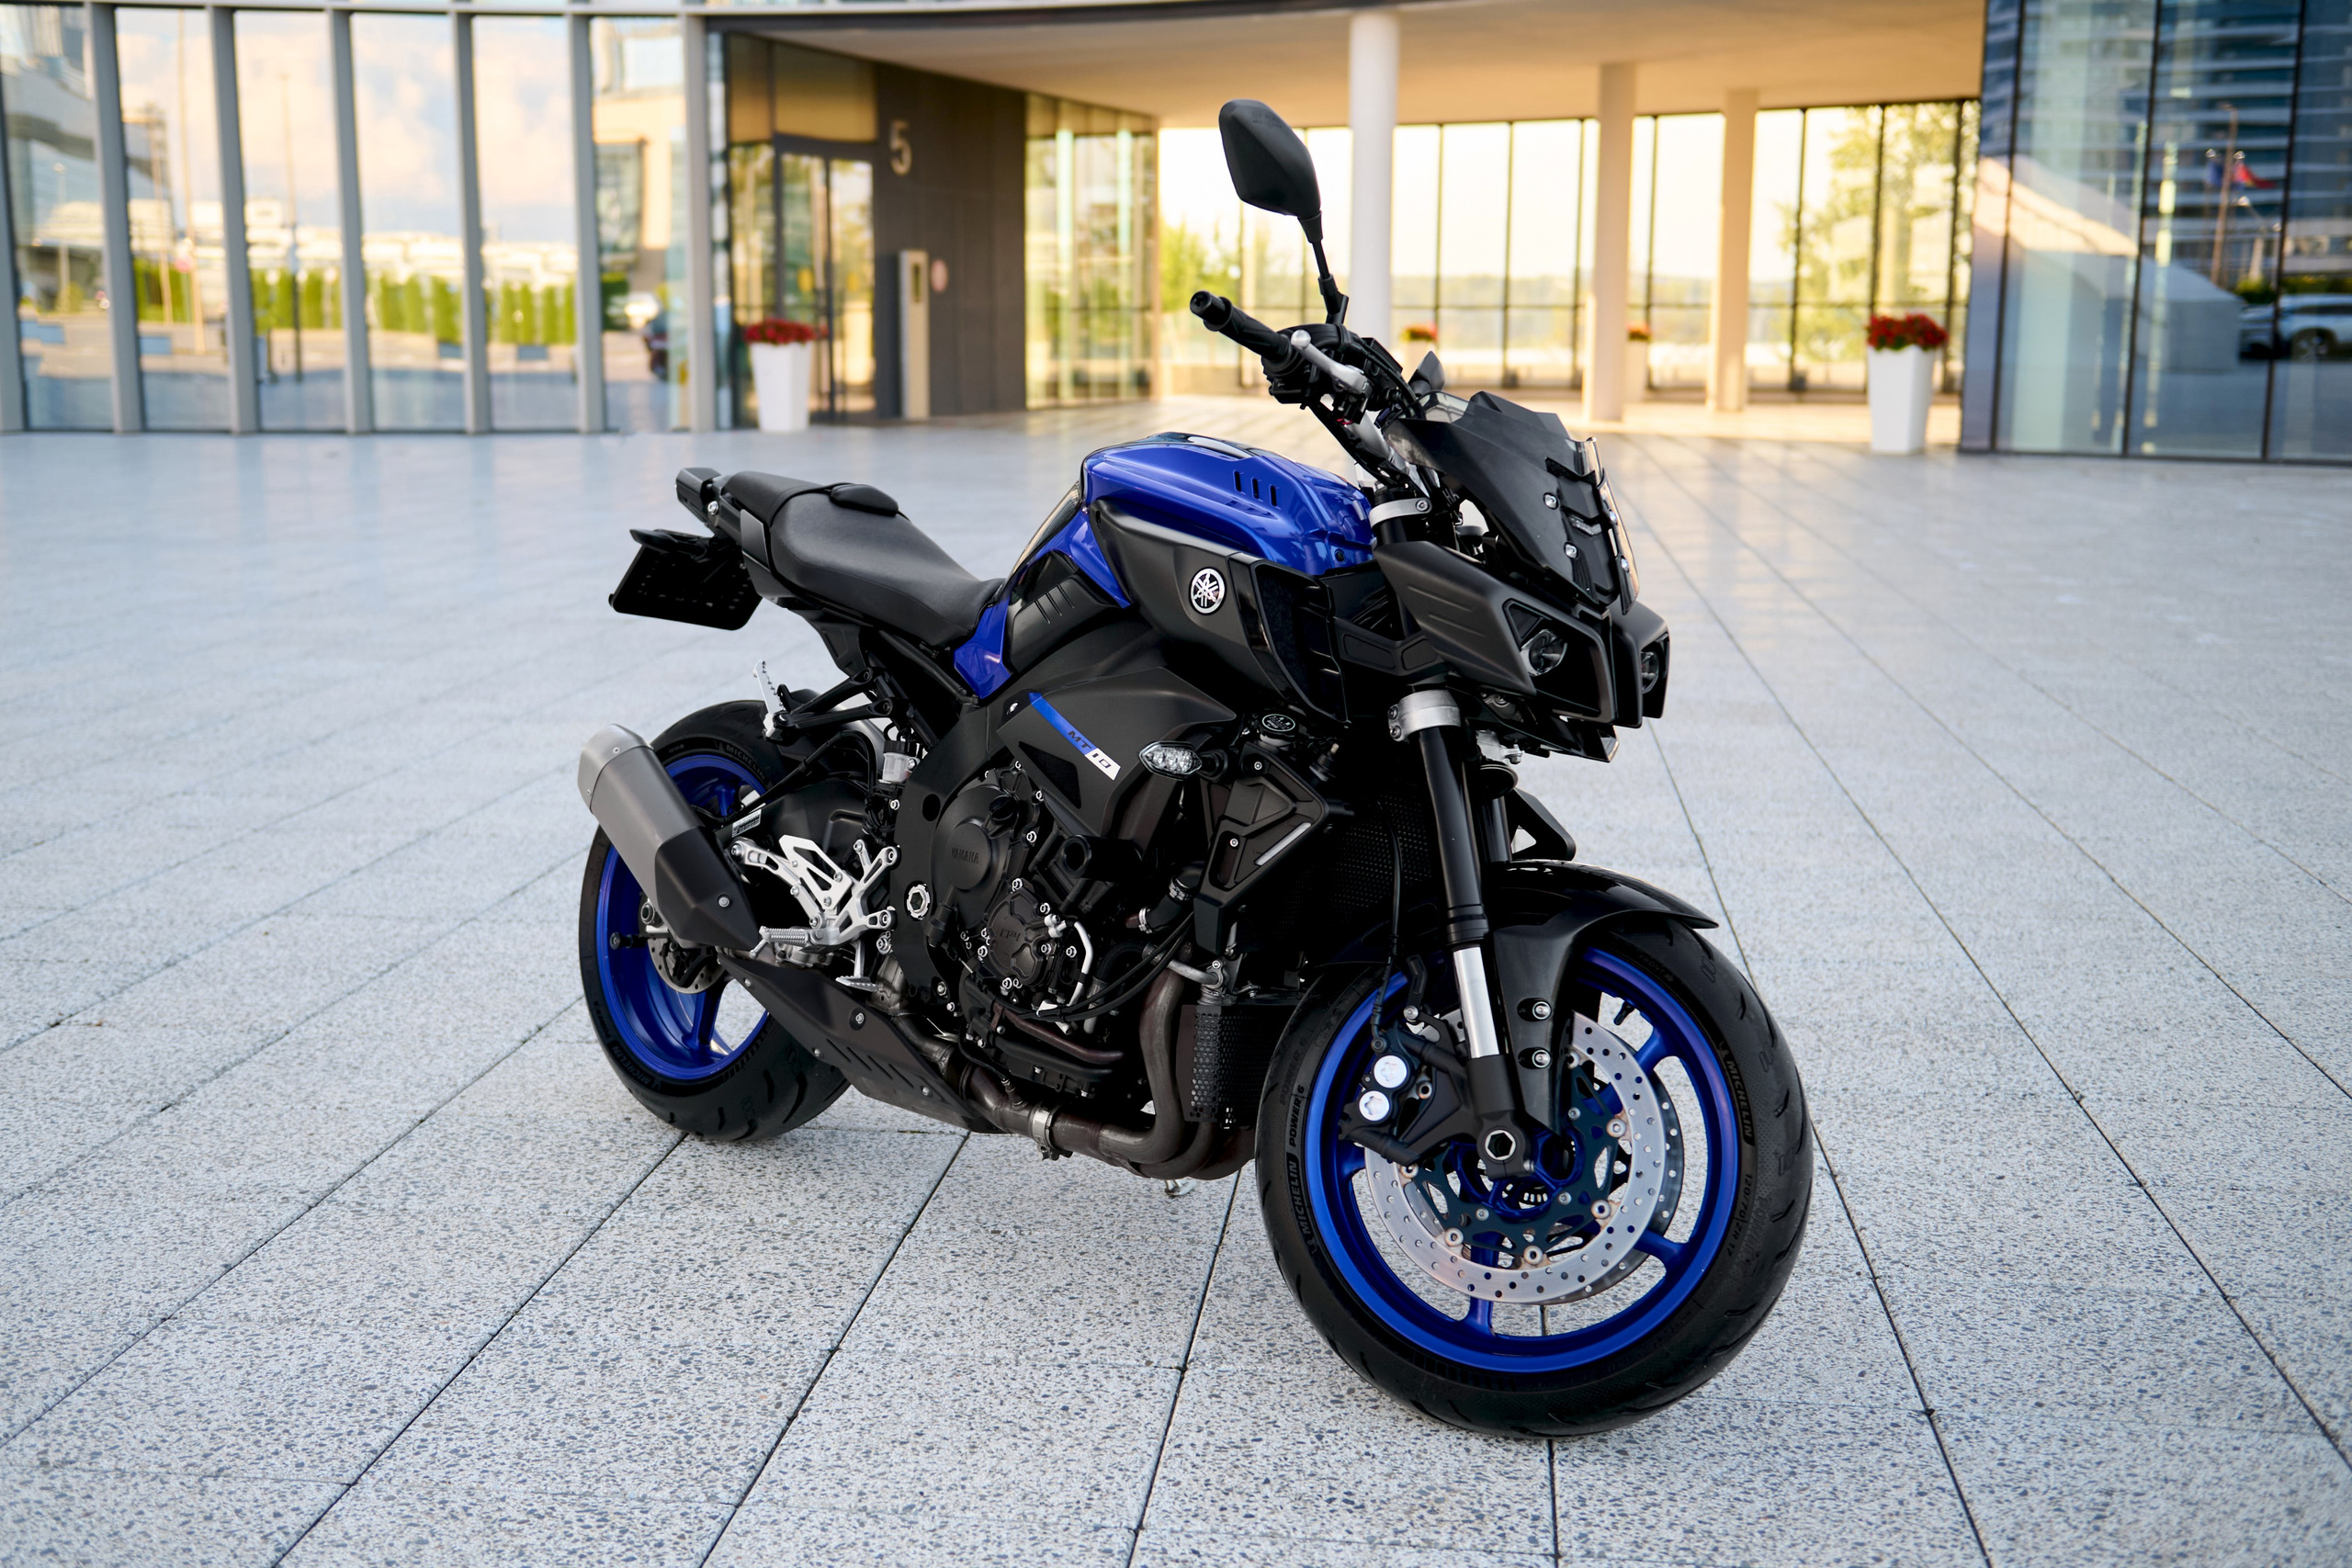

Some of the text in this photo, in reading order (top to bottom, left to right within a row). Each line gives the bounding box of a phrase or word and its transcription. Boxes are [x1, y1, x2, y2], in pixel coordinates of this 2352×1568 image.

[890, 120, 911, 175] 5
[726, 745, 766, 781] MICHELIN
[1068, 730, 1112, 769] MT 10
[951, 846, 979, 864] YAMAHA
[609, 1044, 652, 1086] MICHELIN
[1287, 1084, 1312, 1235] MICHELIN POWER 6
[1726, 1059, 1754, 1257] MICHELIN 120/70 ZR 17
